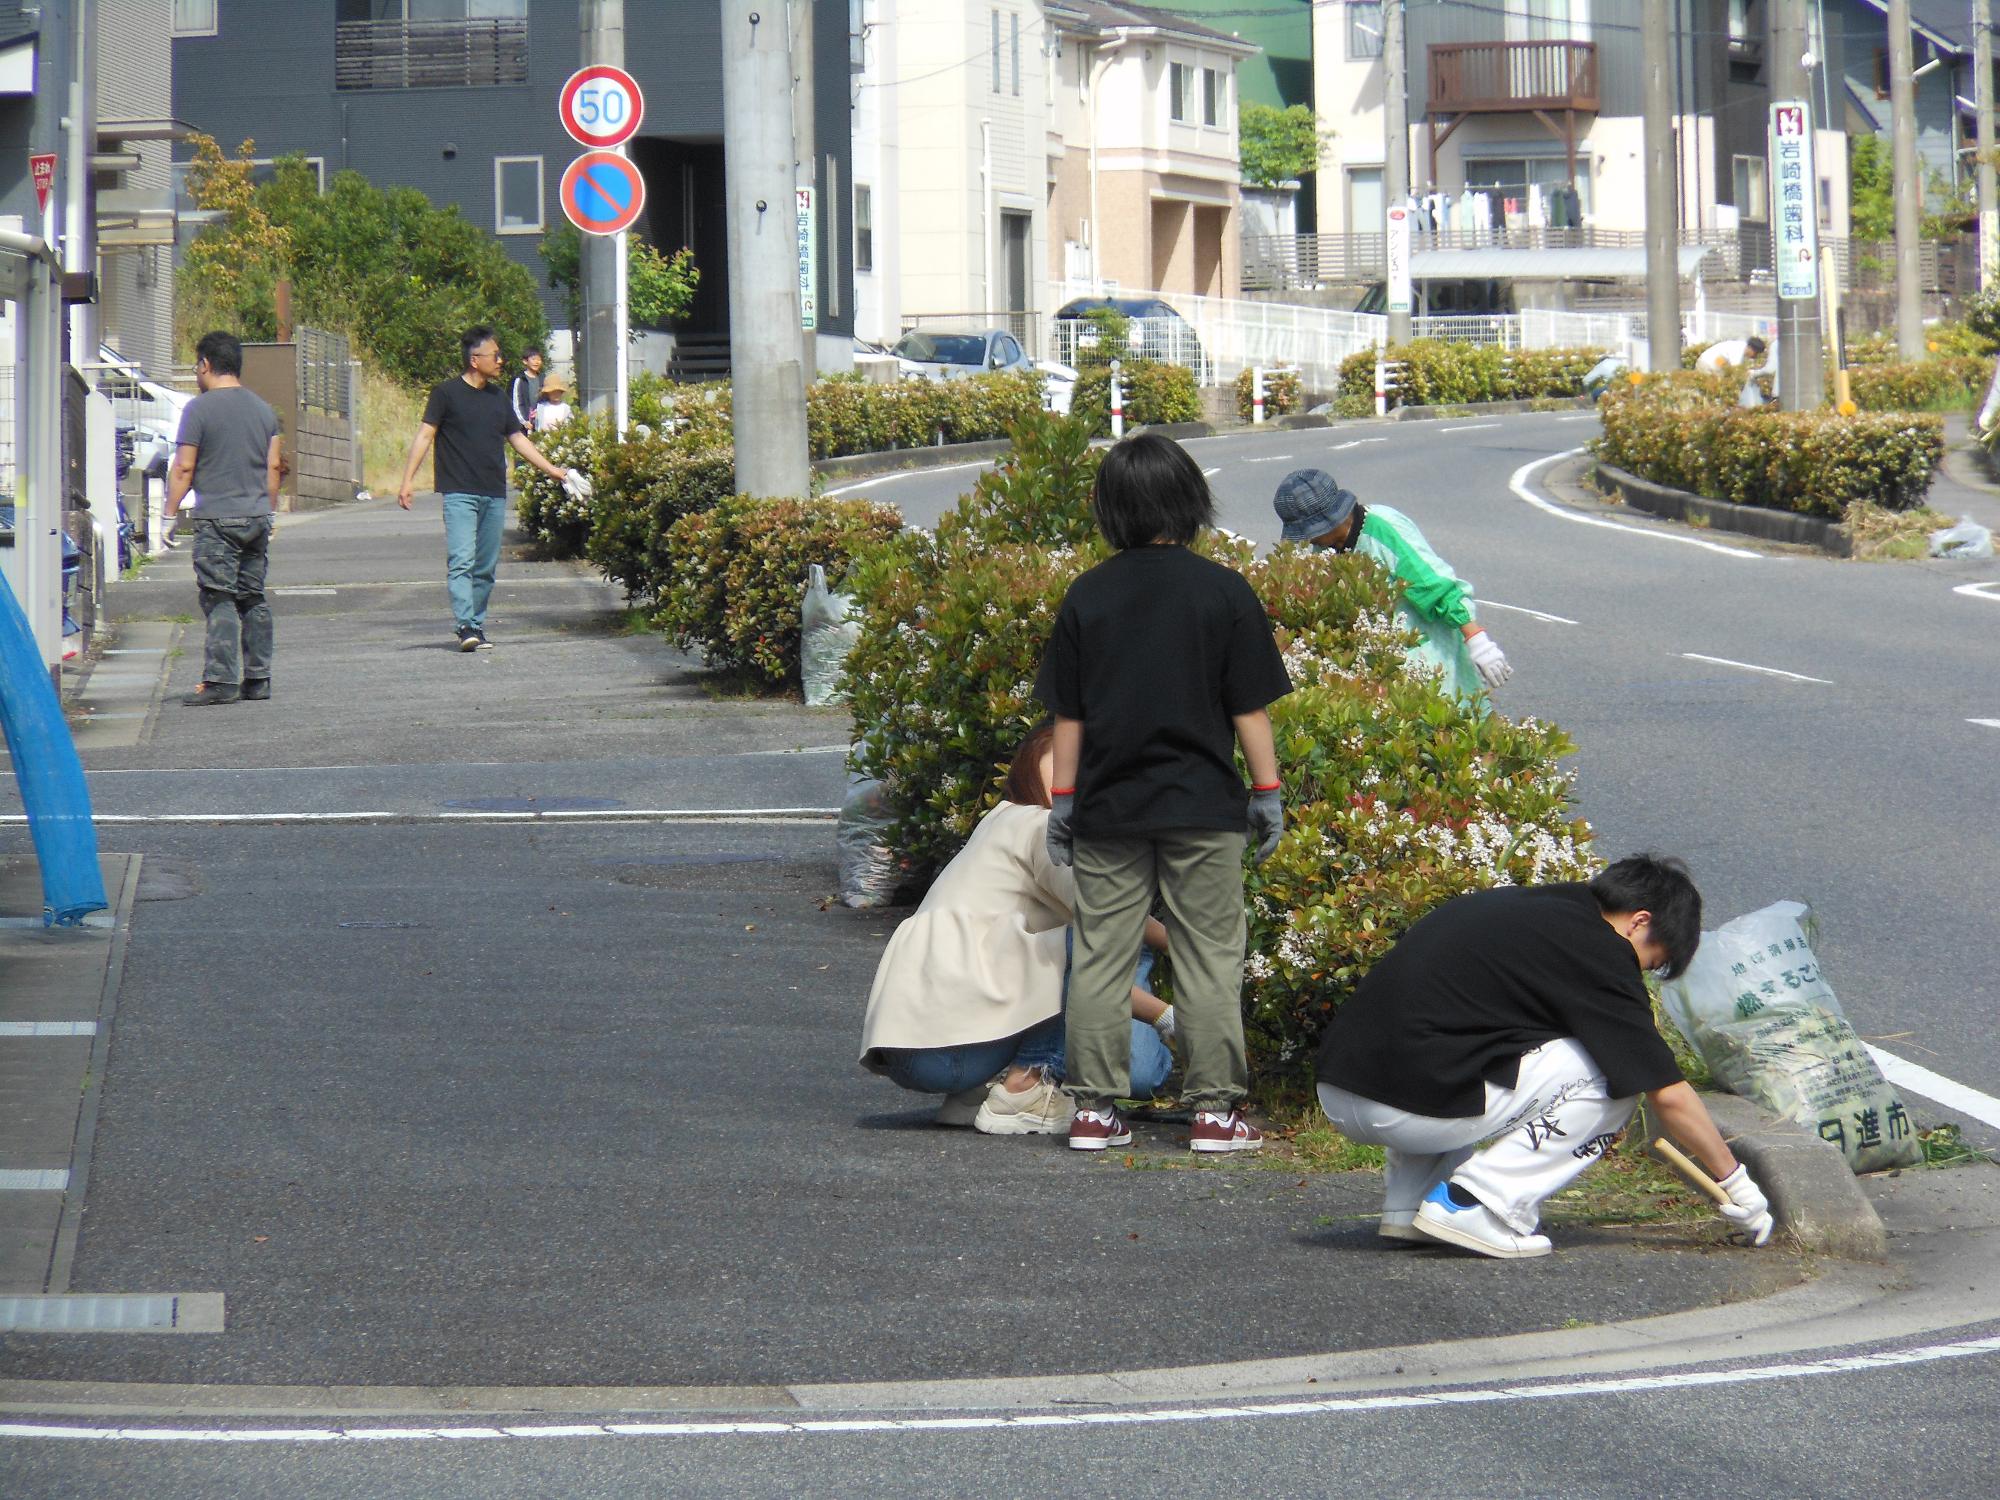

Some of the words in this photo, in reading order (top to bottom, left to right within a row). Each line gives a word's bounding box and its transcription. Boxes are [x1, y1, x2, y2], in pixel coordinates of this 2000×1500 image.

[580, 90, 623, 124] 50
[1781, 140, 1804, 243] 岩崎橋歯科
[1818, 1101, 1909, 1153] 日進市
